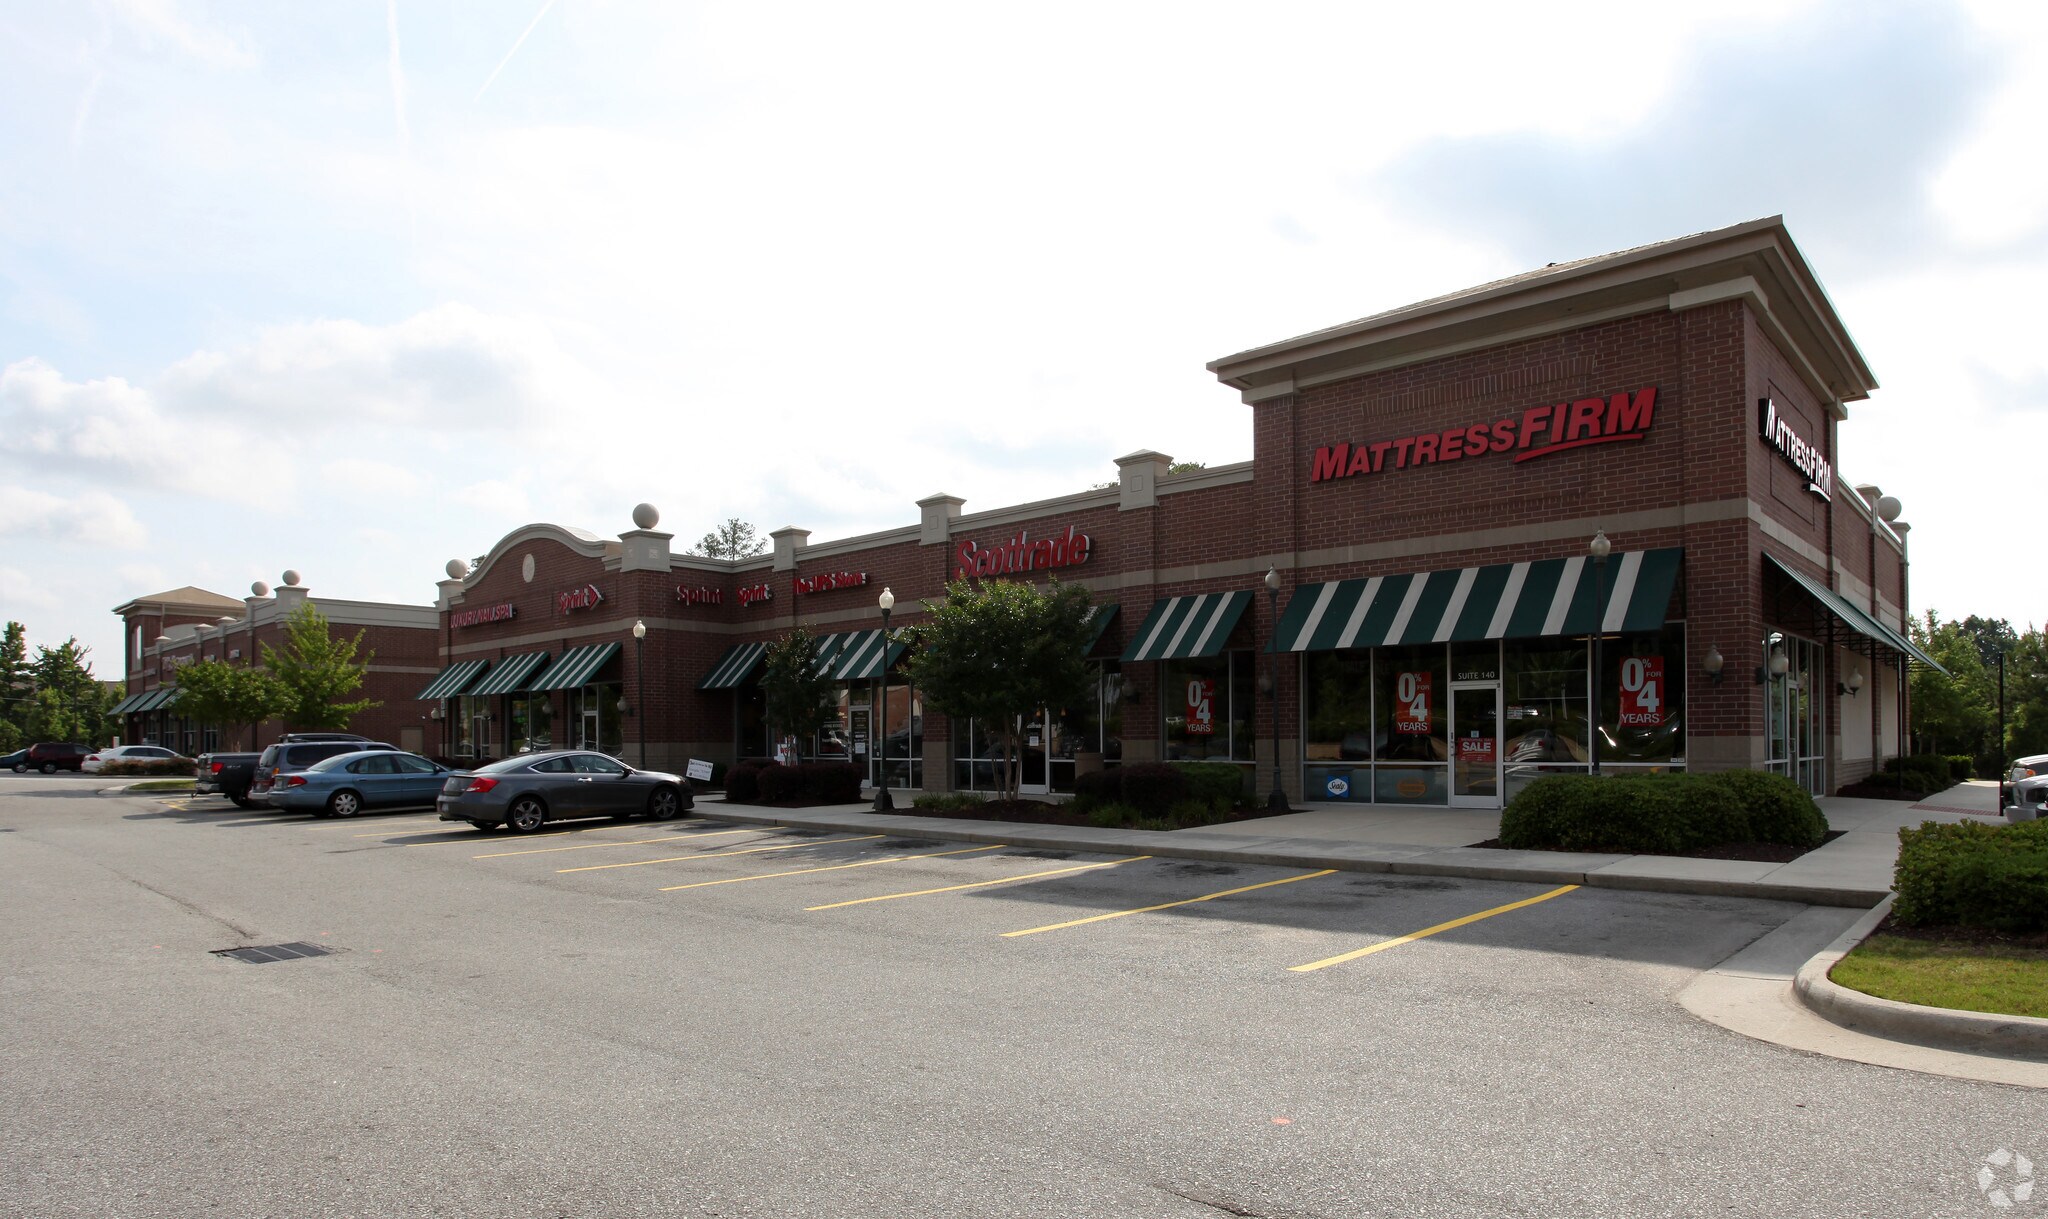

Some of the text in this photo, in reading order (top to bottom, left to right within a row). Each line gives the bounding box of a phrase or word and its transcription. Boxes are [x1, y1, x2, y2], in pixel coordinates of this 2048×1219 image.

[952, 525, 1090, 580] Scottrade
[736, 583, 771, 607] Sprint
[793, 572, 867, 595] The UPS Store
[558, 585, 589, 615] Sprint
[676, 585, 724, 606] Sprint
[450, 603, 513, 629] LUXURY NAIL SPA
[1457, 670, 1495, 680] SUITE 140
[1409, 692, 1428, 722] 4
[1636, 680, 1660, 713] 4
[1196, 698, 1211, 724] 4
[1621, 713, 1660, 724] YEARS
[1187, 723, 1211, 732] YEARS
[1397, 721, 1428, 731] YEARS
[1462, 741, 1492, 752] SALE
